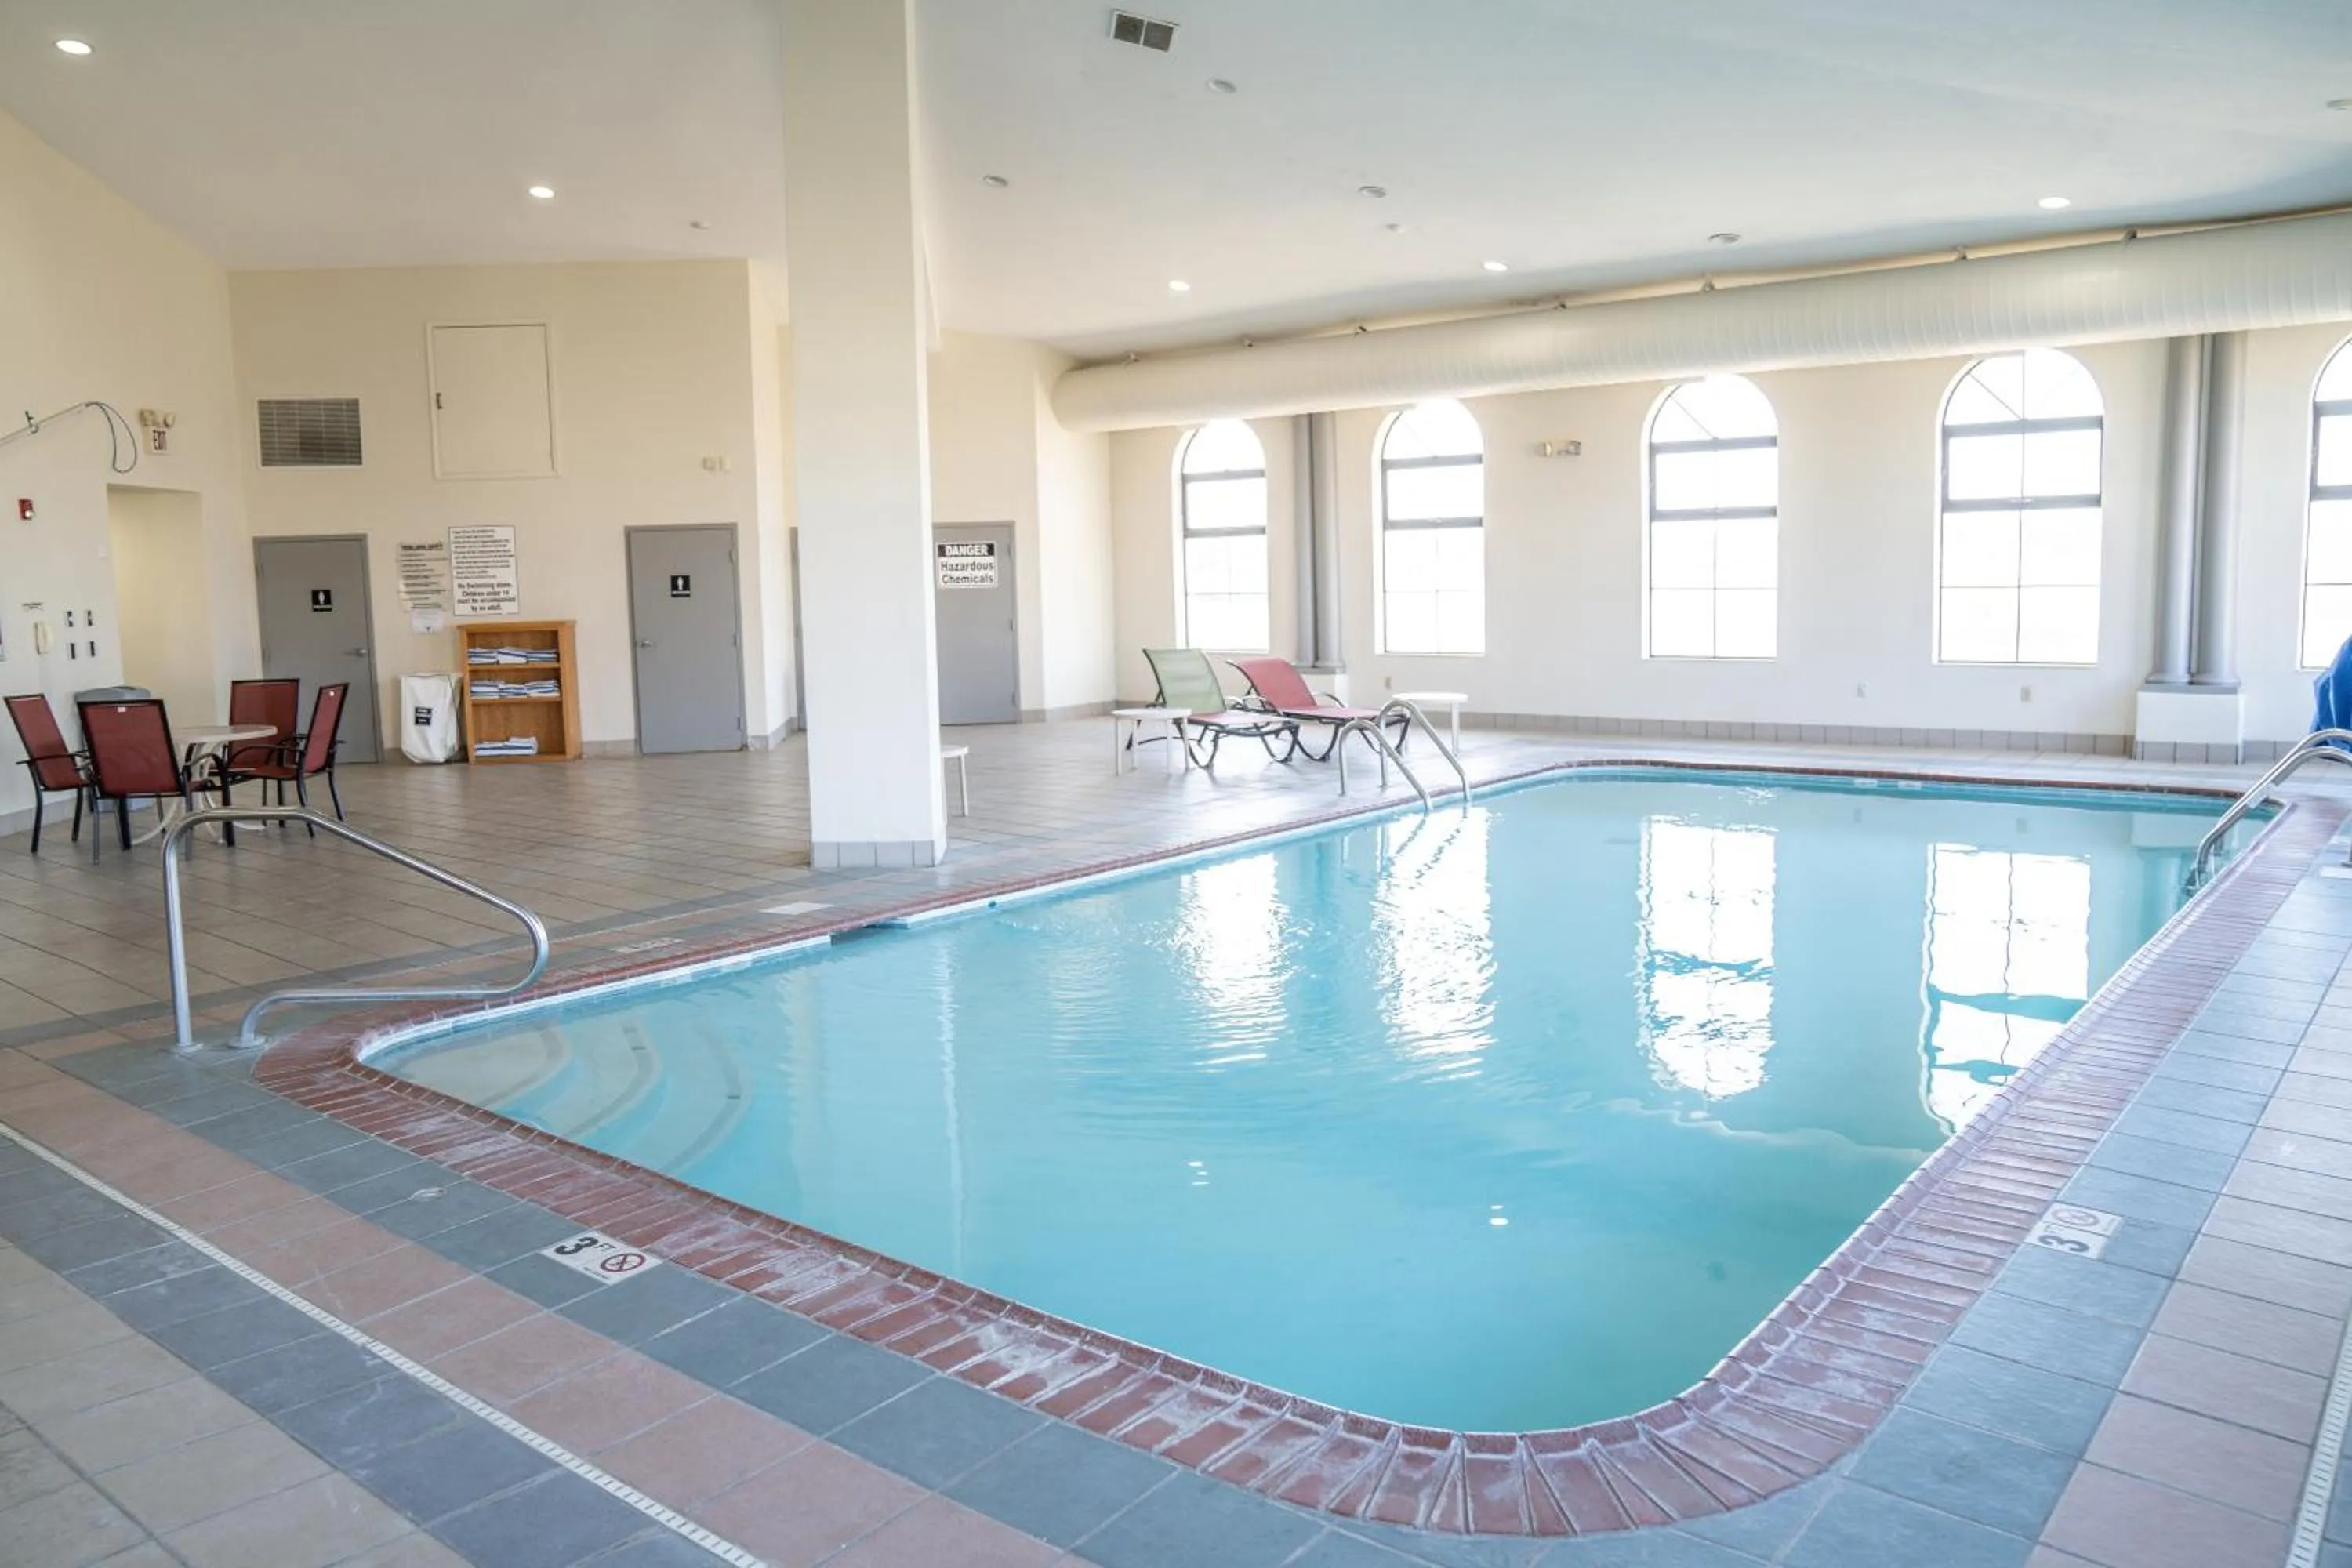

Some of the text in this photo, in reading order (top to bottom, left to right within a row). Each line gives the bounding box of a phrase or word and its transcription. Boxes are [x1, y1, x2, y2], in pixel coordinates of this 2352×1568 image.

[945, 544, 989, 556] DANGER
[941, 561, 994, 571] Hazardous
[942, 574, 993, 584] Chemicals
[554, 1236, 598, 1255] 3
[2038, 1233, 2089, 1252] 3
